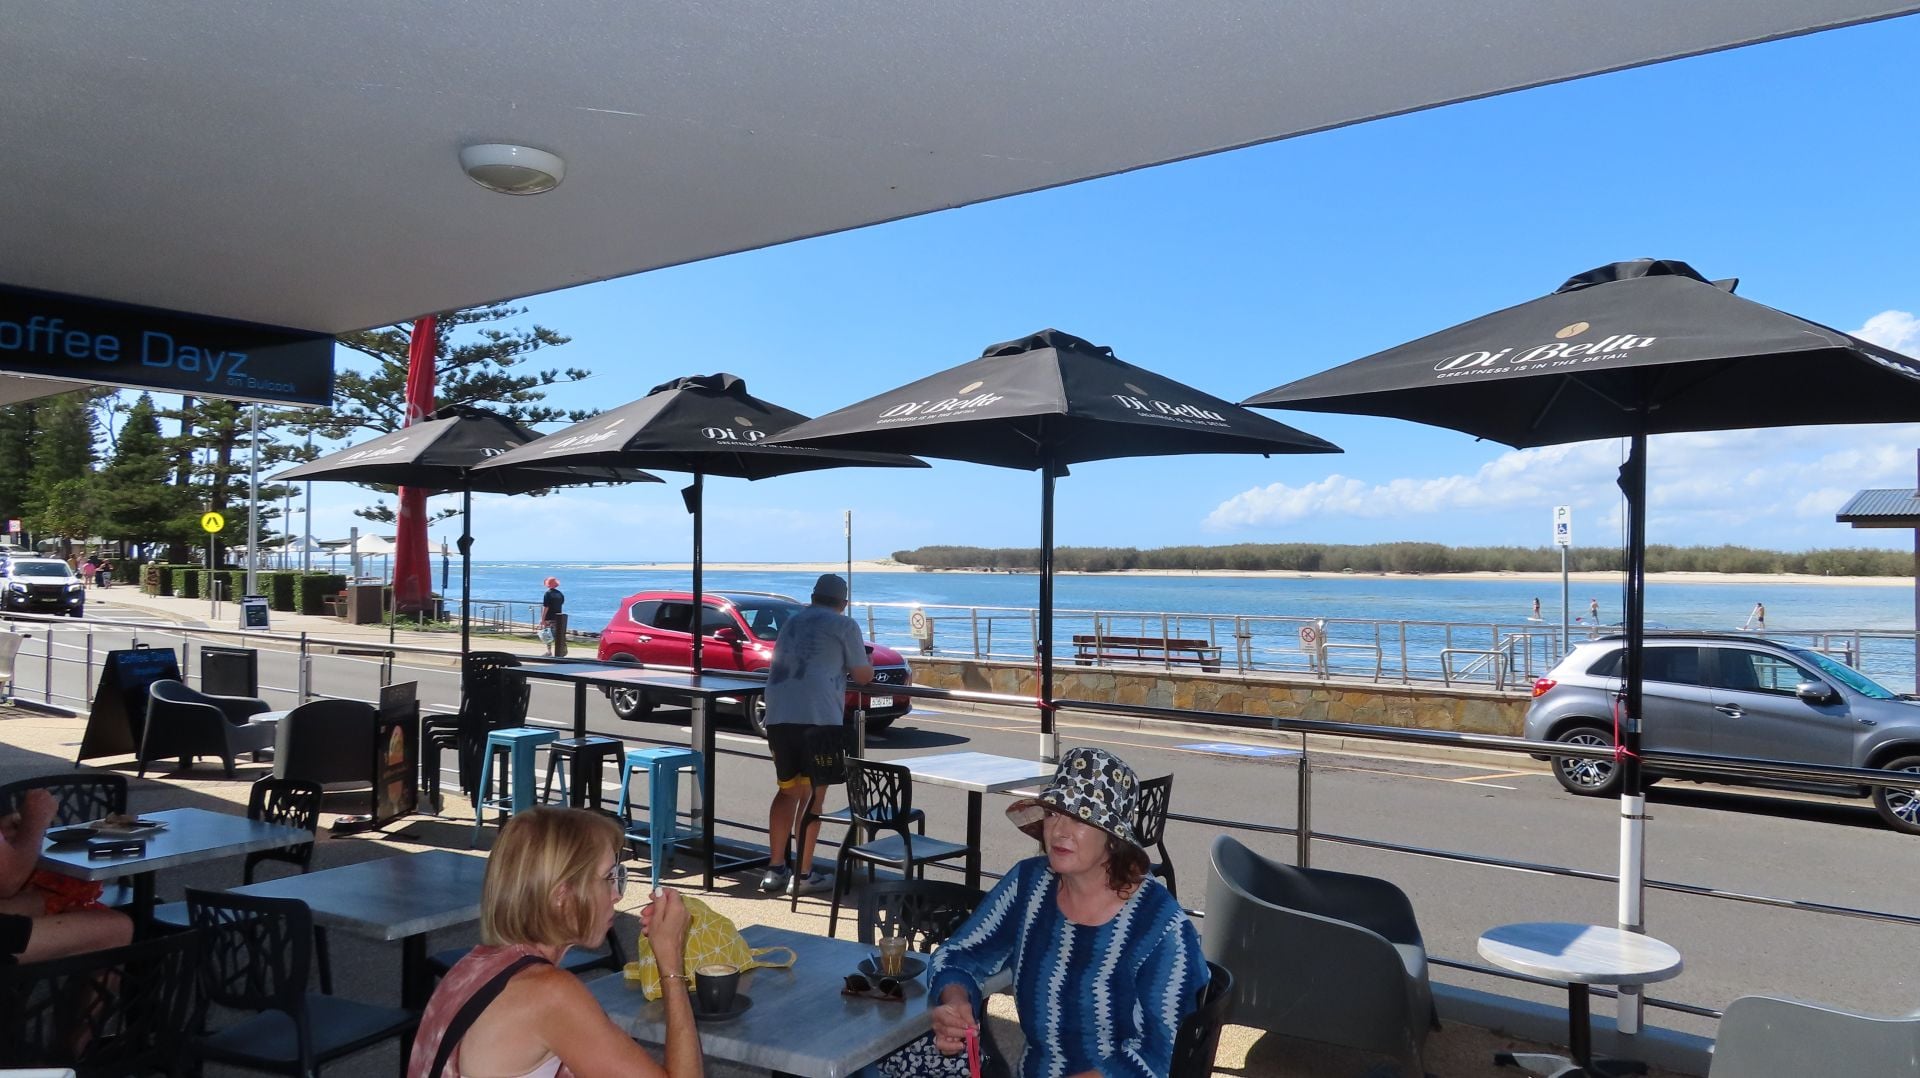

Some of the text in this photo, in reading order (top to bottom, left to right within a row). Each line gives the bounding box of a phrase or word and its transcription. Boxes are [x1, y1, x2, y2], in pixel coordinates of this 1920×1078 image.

[0, 316, 249, 382] offee Dayz
[1433, 333, 1657, 371] Di Bella
[1437, 366, 1511, 379] GREATNESS
[1514, 364, 1528, 372] IS
[1551, 358, 1579, 367] THE
[1582, 352, 1629, 363] DETAIL
[226, 376, 297, 393] on Bulcock
[879, 392, 1004, 418] Di Bella
[1111, 394, 1227, 421] Di Bella
[701, 427, 739, 440] Di
